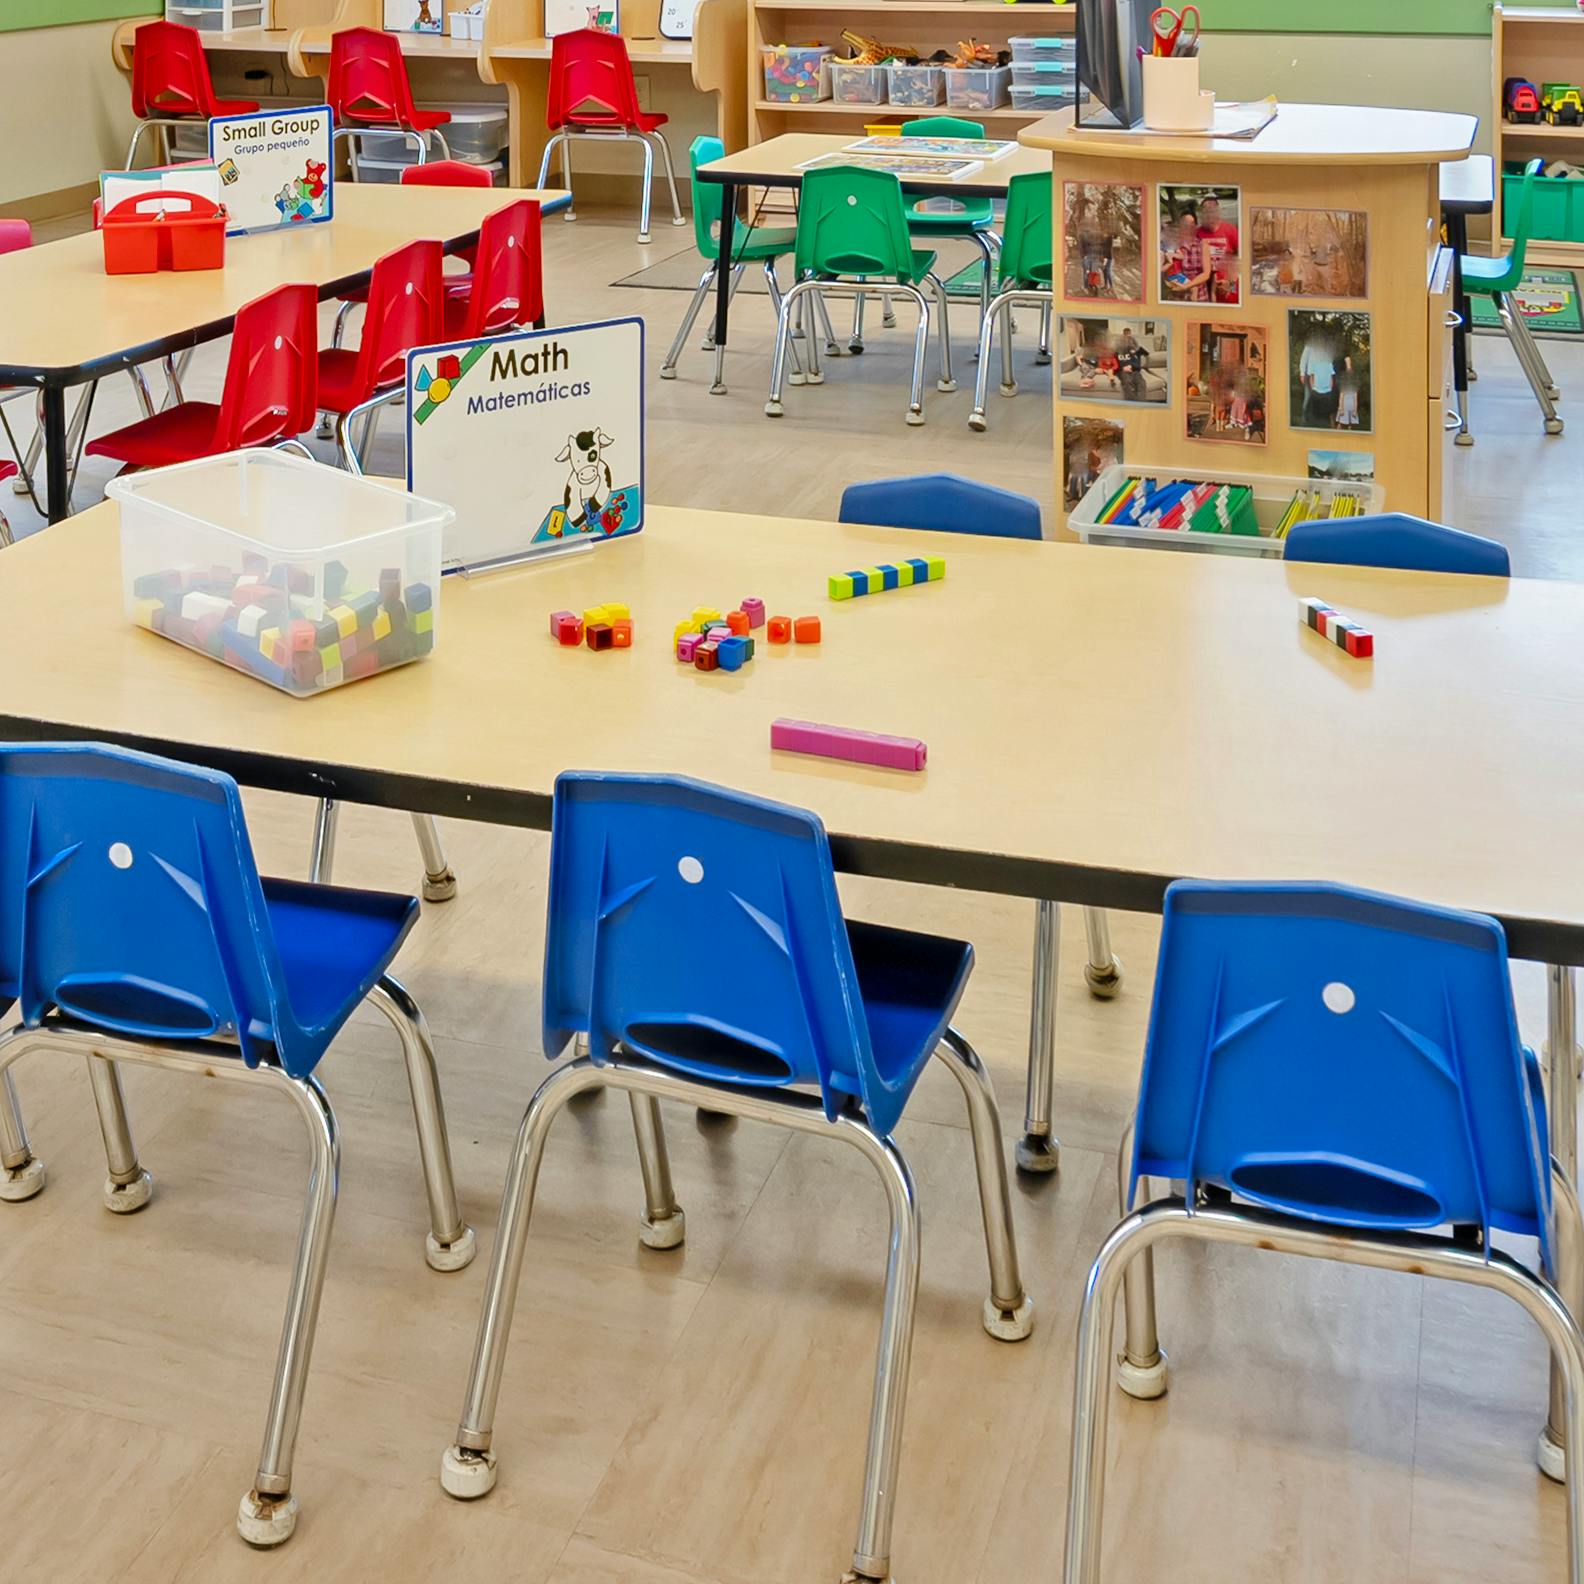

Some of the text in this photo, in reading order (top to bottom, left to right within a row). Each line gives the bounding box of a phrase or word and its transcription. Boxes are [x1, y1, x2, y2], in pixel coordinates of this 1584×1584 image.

[676, 21, 684, 29] 25
[223, 119, 320, 141] Small Group
[234, 137, 310, 155] Grupo pequeño
[489, 341, 569, 382] Math
[467, 379, 591, 416] Matemáticas
